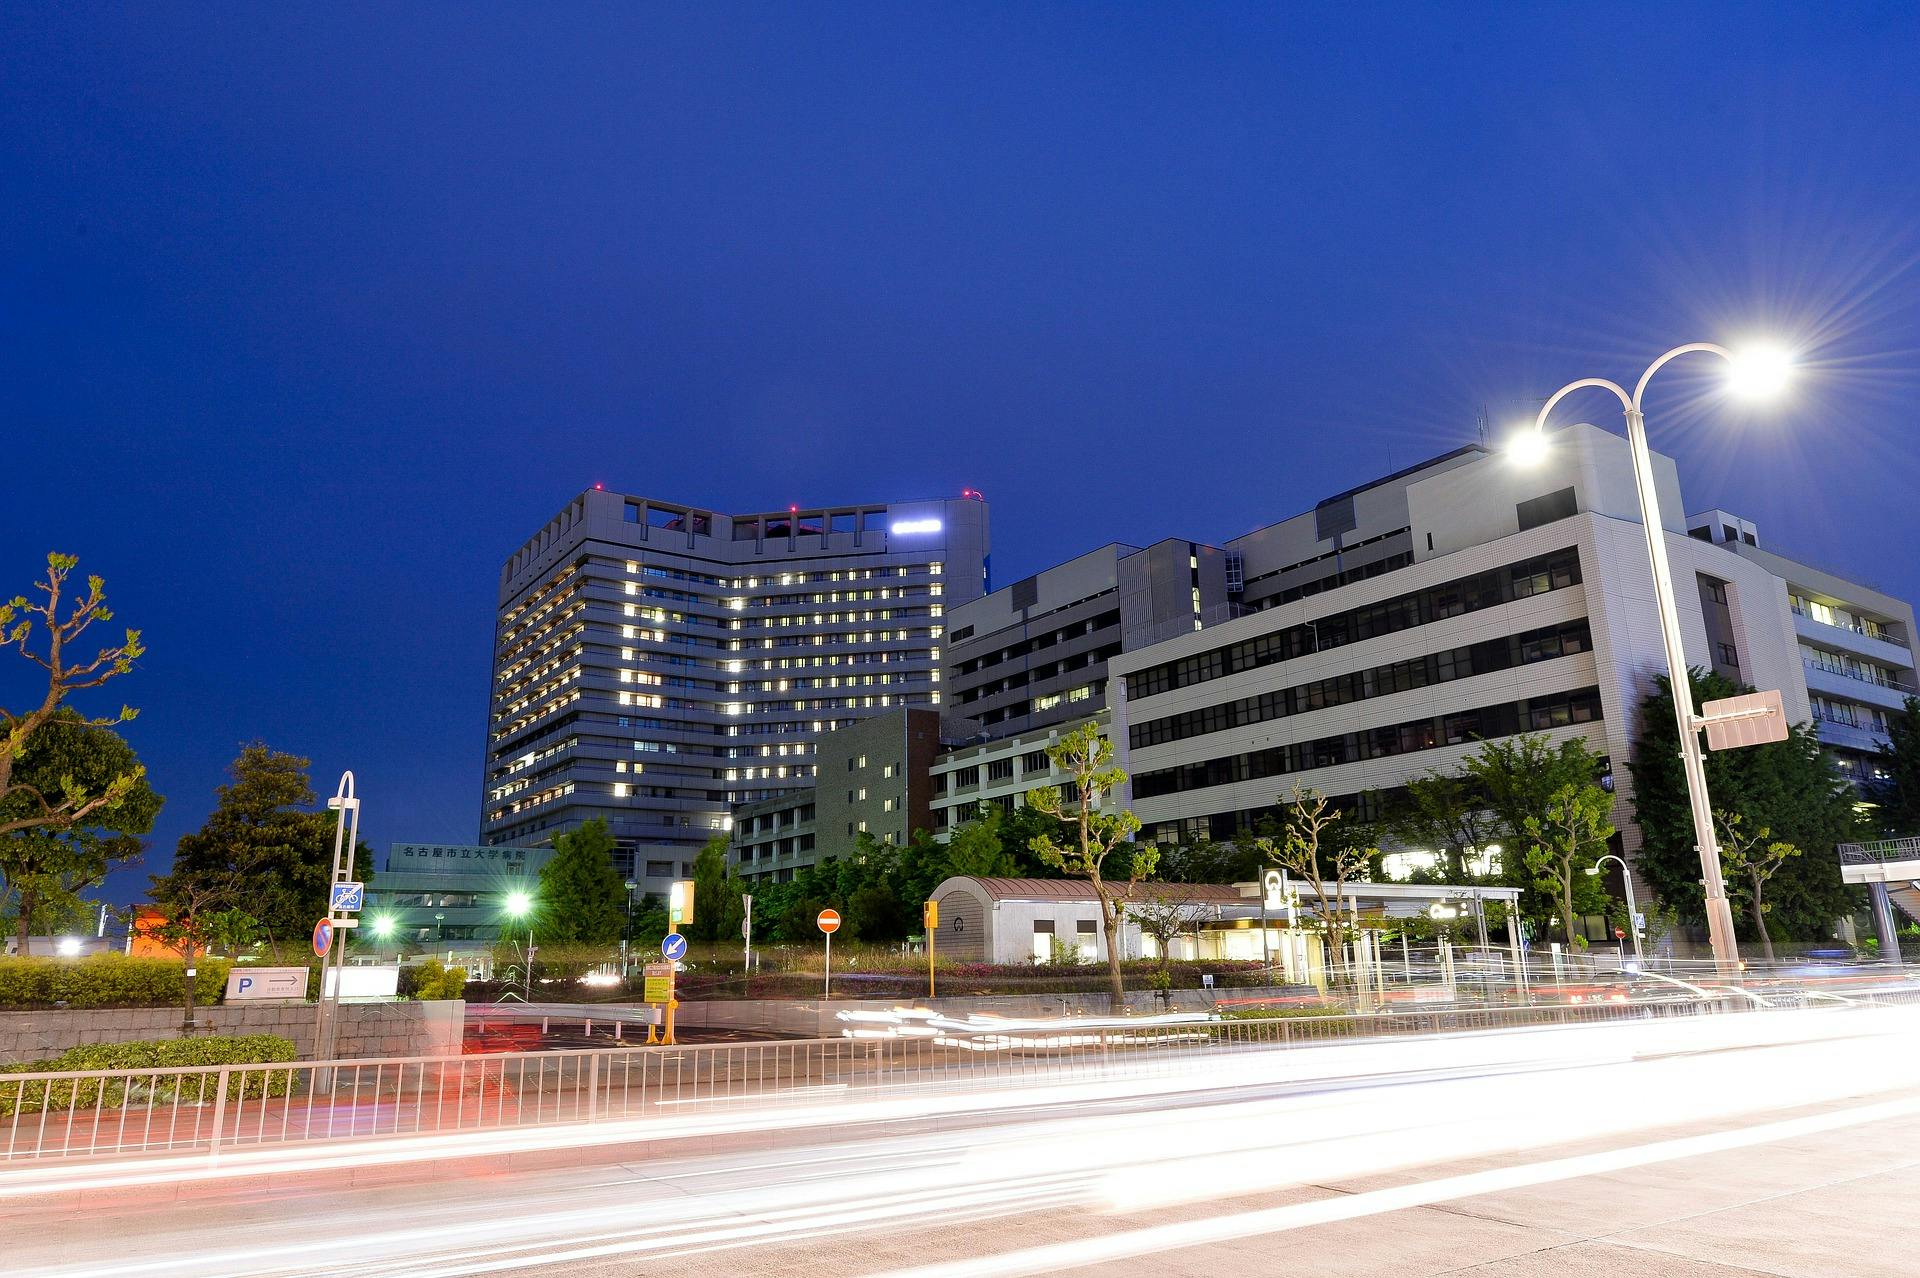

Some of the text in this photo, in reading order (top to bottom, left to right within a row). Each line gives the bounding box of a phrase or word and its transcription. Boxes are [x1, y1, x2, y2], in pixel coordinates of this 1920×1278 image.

[403, 846, 526, 860] 名古屋市立大学病院
[239, 978, 253, 993] P
